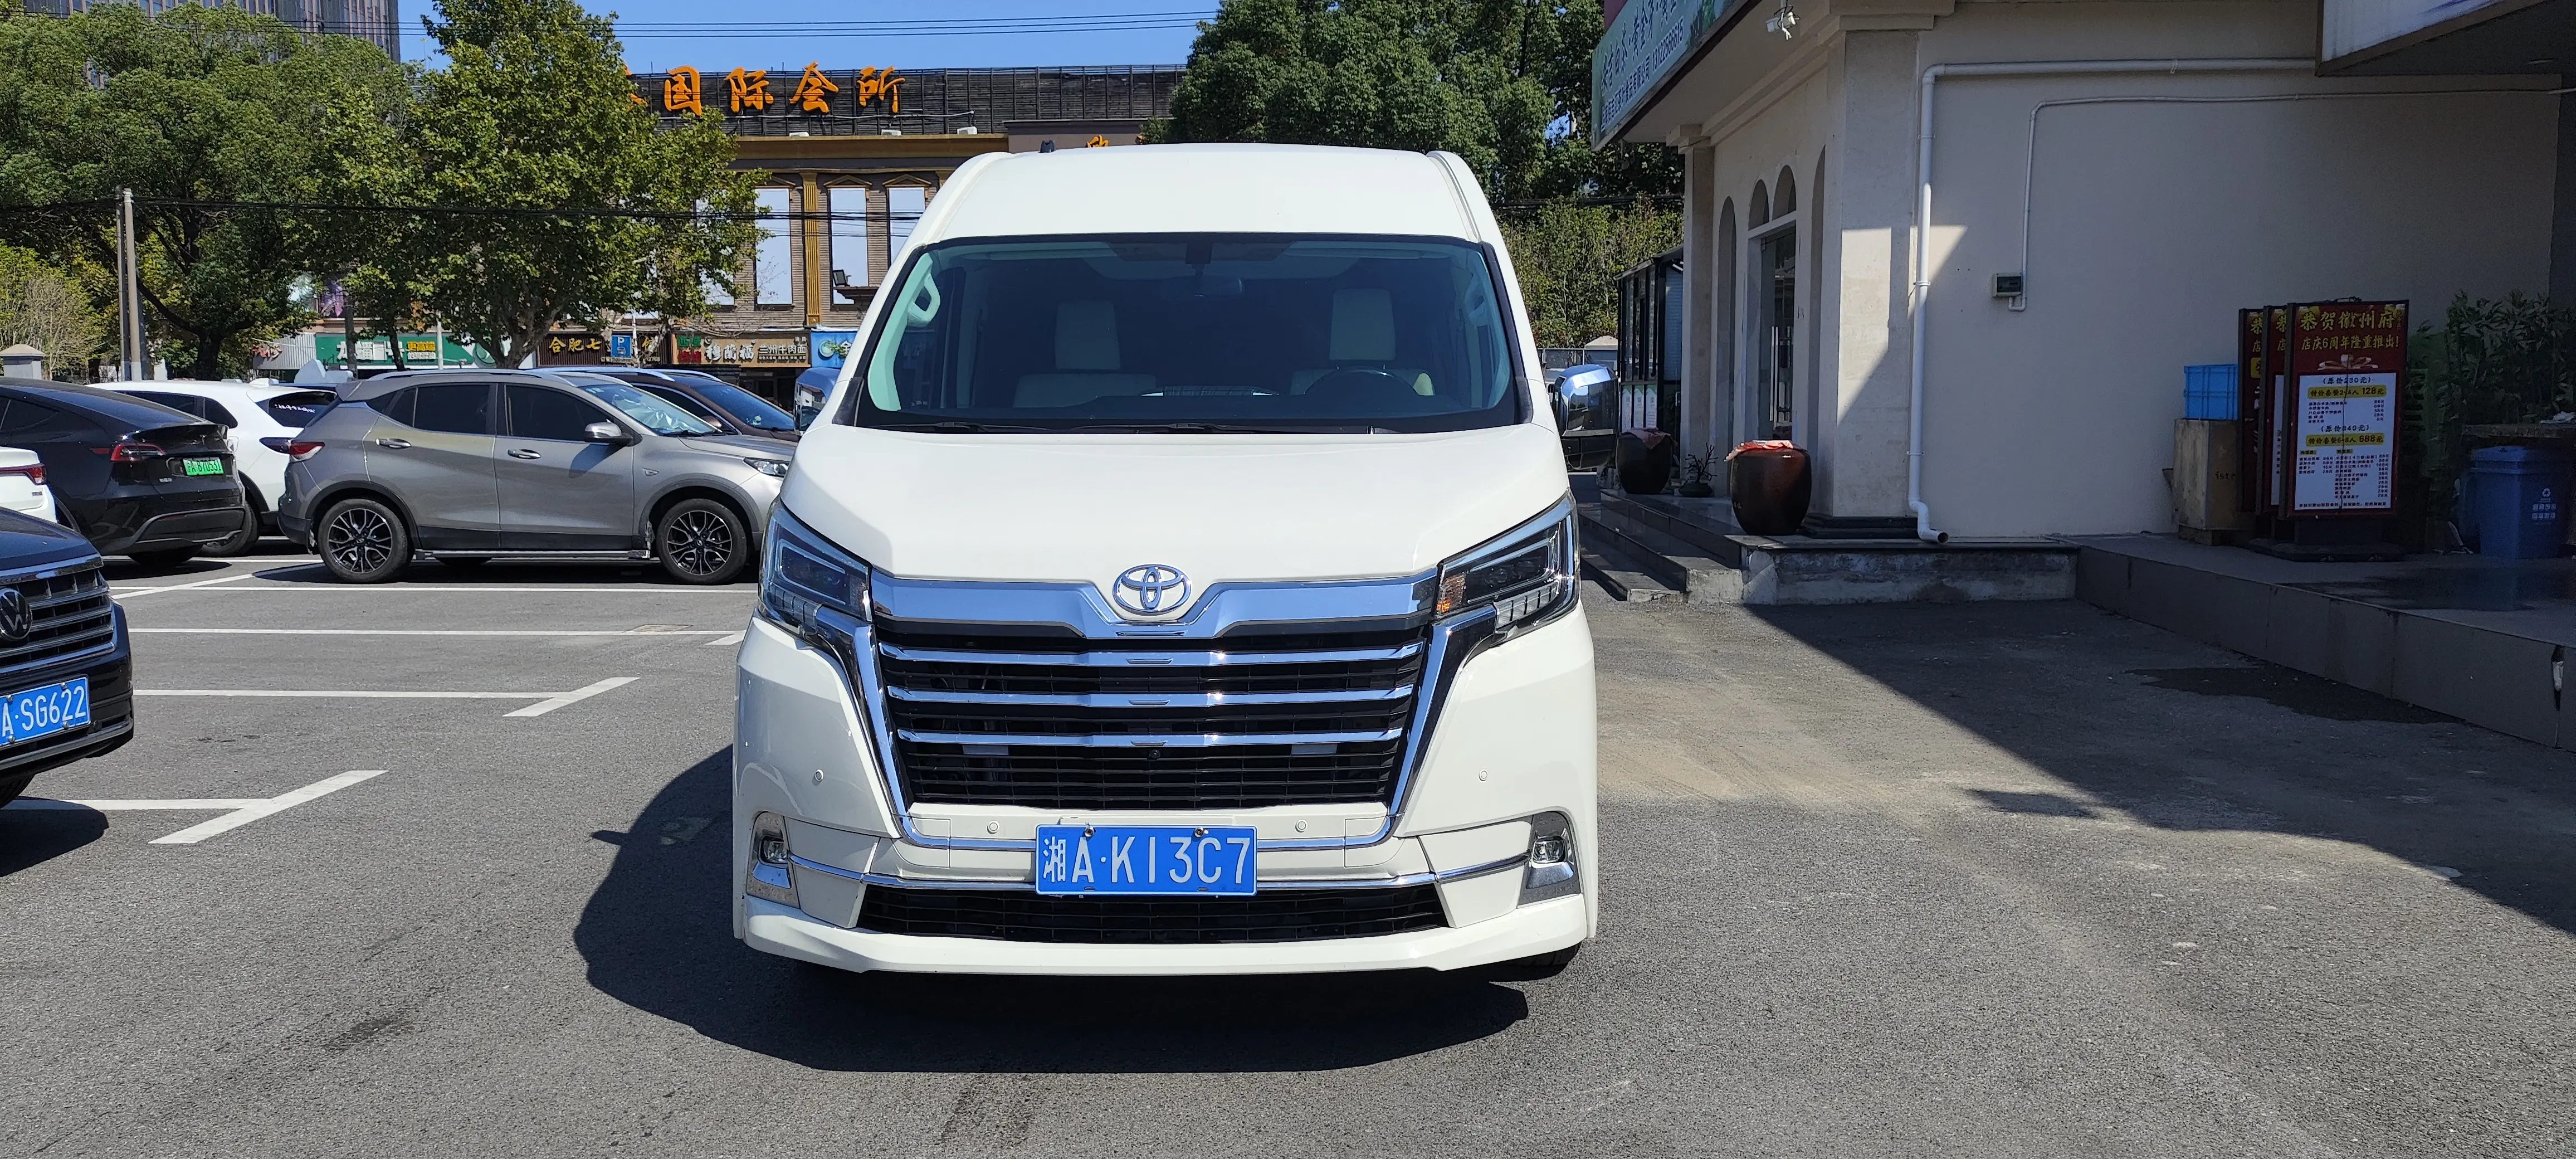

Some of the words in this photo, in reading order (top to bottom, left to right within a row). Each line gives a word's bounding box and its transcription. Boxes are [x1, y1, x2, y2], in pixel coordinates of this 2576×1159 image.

[625, 61, 905, 116] 国际会所
[2300, 310, 2395, 331] 恭贺徽州府
[617, 337, 625, 345] P
[759, 344, 806, 354] 兰州牛肉面
[1043, 836, 1250, 884] 湘A·K13C7
